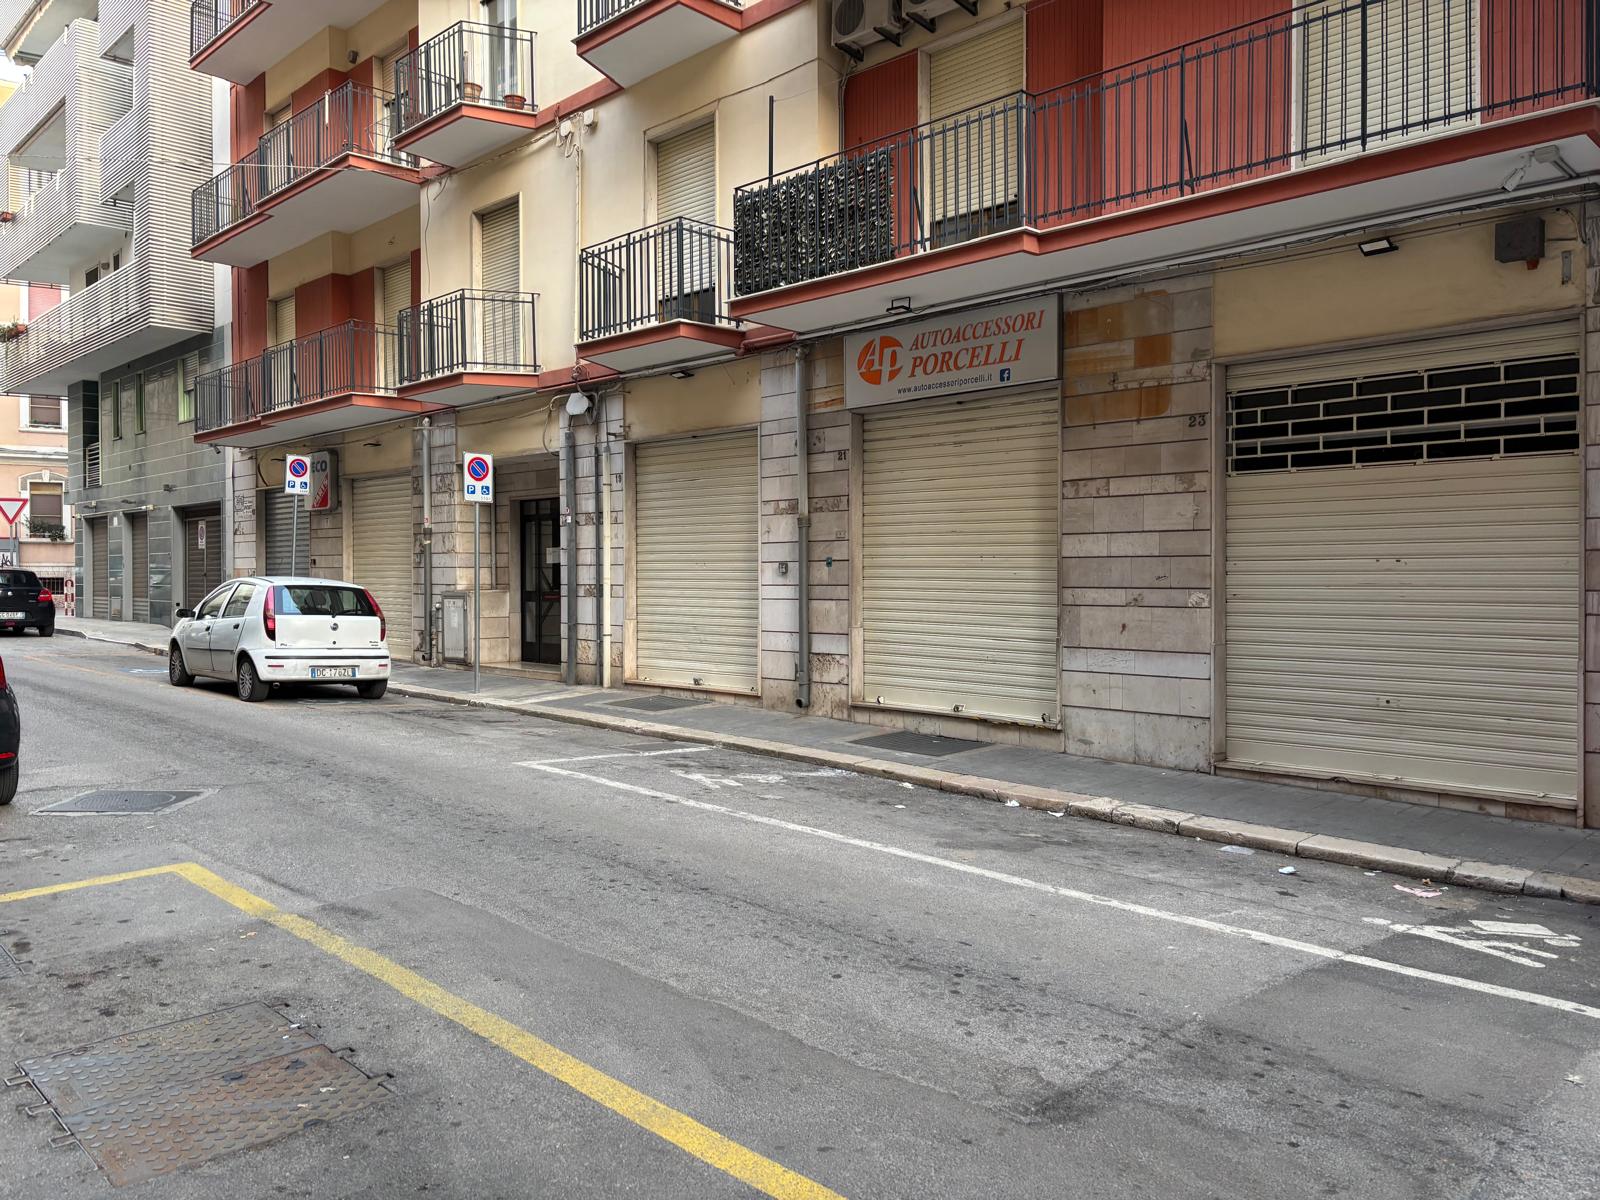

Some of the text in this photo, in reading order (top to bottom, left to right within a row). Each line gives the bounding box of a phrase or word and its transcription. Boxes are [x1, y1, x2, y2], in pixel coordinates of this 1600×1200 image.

[909, 309, 1045, 352] AUTOACCESSORI
[909, 338, 1025, 378] PORCELLI
[897, 374, 992, 395] www.autoaccessoriporcelli.it
[1188, 415, 1206, 428] 23
[837, 451, 847, 461] 21
[468, 485, 475, 494] P
